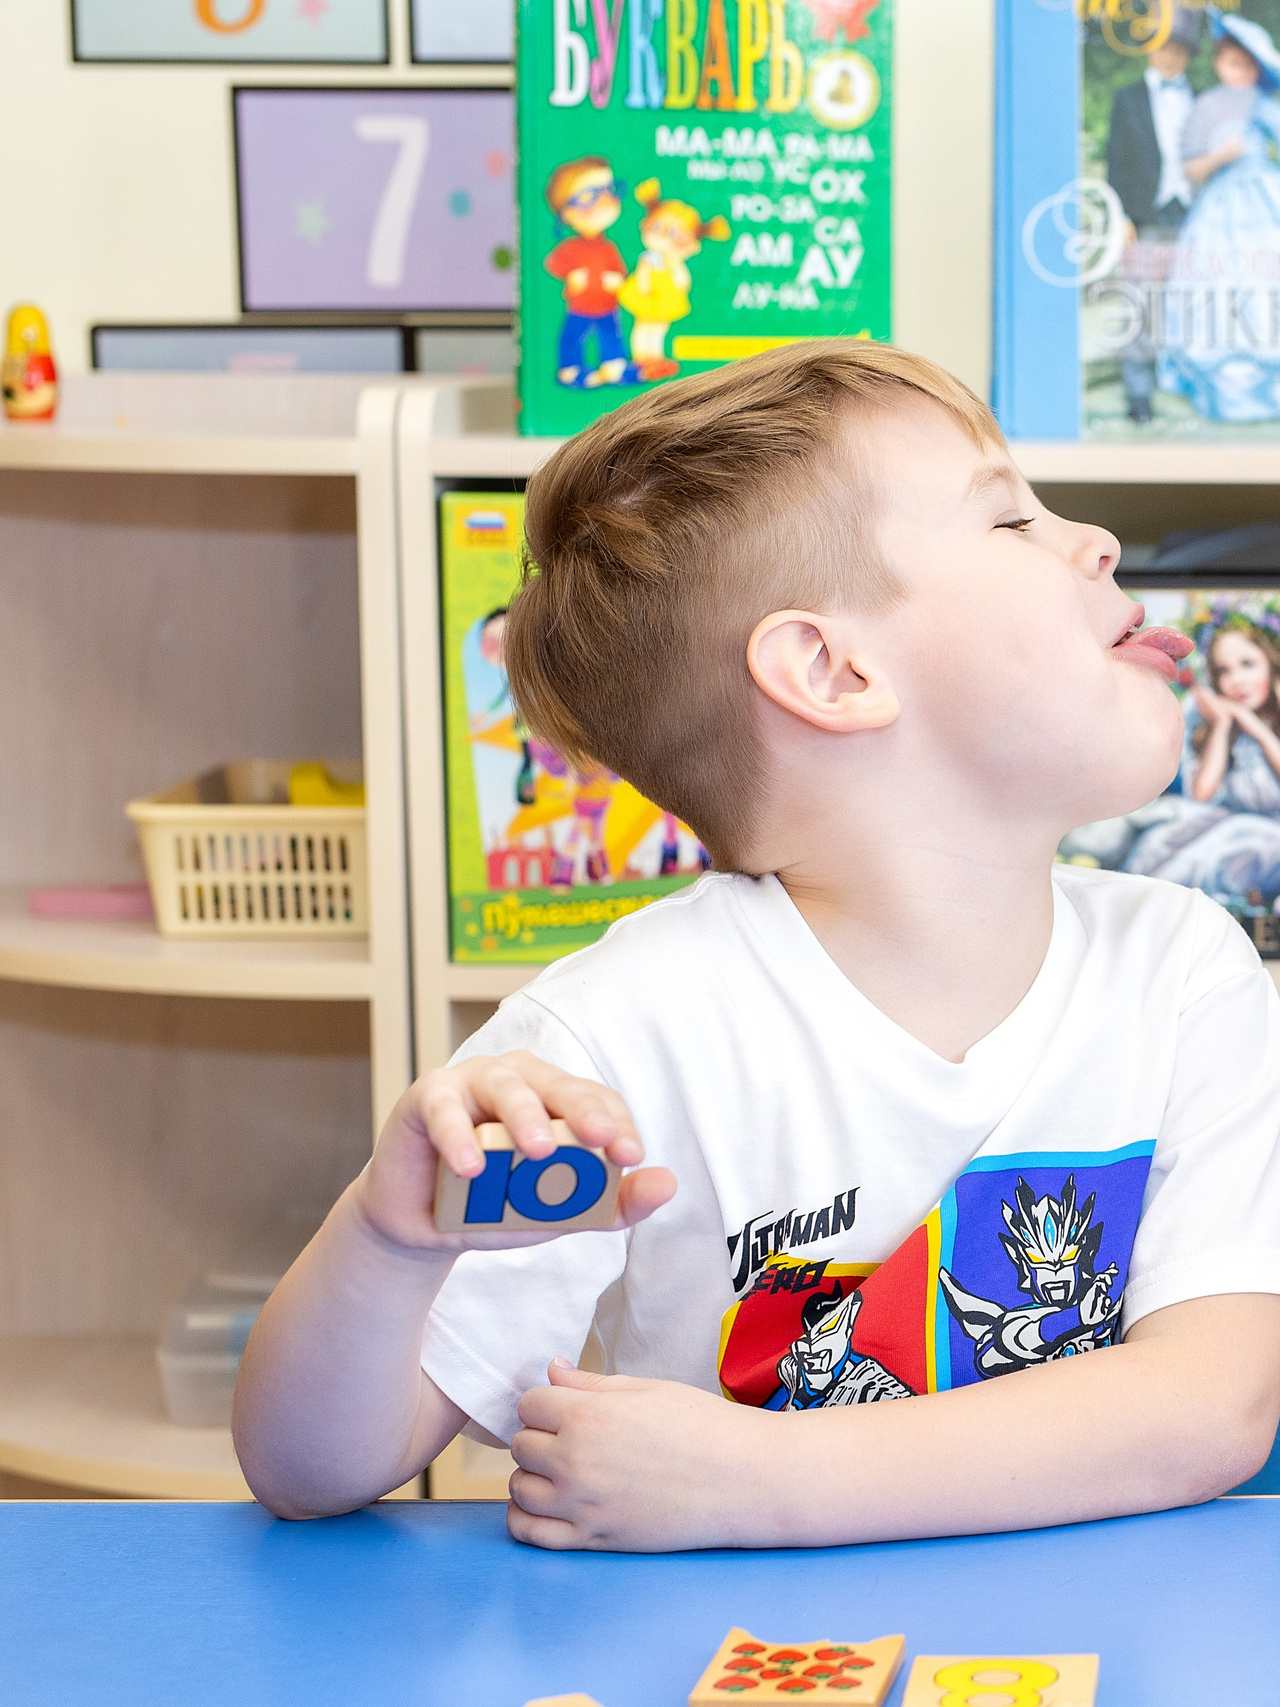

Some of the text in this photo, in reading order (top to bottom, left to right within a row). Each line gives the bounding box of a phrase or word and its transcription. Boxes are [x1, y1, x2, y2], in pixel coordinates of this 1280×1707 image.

[549, 0, 804, 112] БУКВАРЬ
[655, 125, 779, 160] МА-МА
[356, 115, 429, 288] 7
[810, 167, 866, 204] ОХ
[730, 193, 817, 223] РО-ЗА
[730, 231, 794, 267] АМ
[814, 215, 862, 247] СА
[796, 244, 865, 289] АУ
[464, 1146, 607, 1223] 10
[727, 1186, 861, 1293] ULTRAMAN
